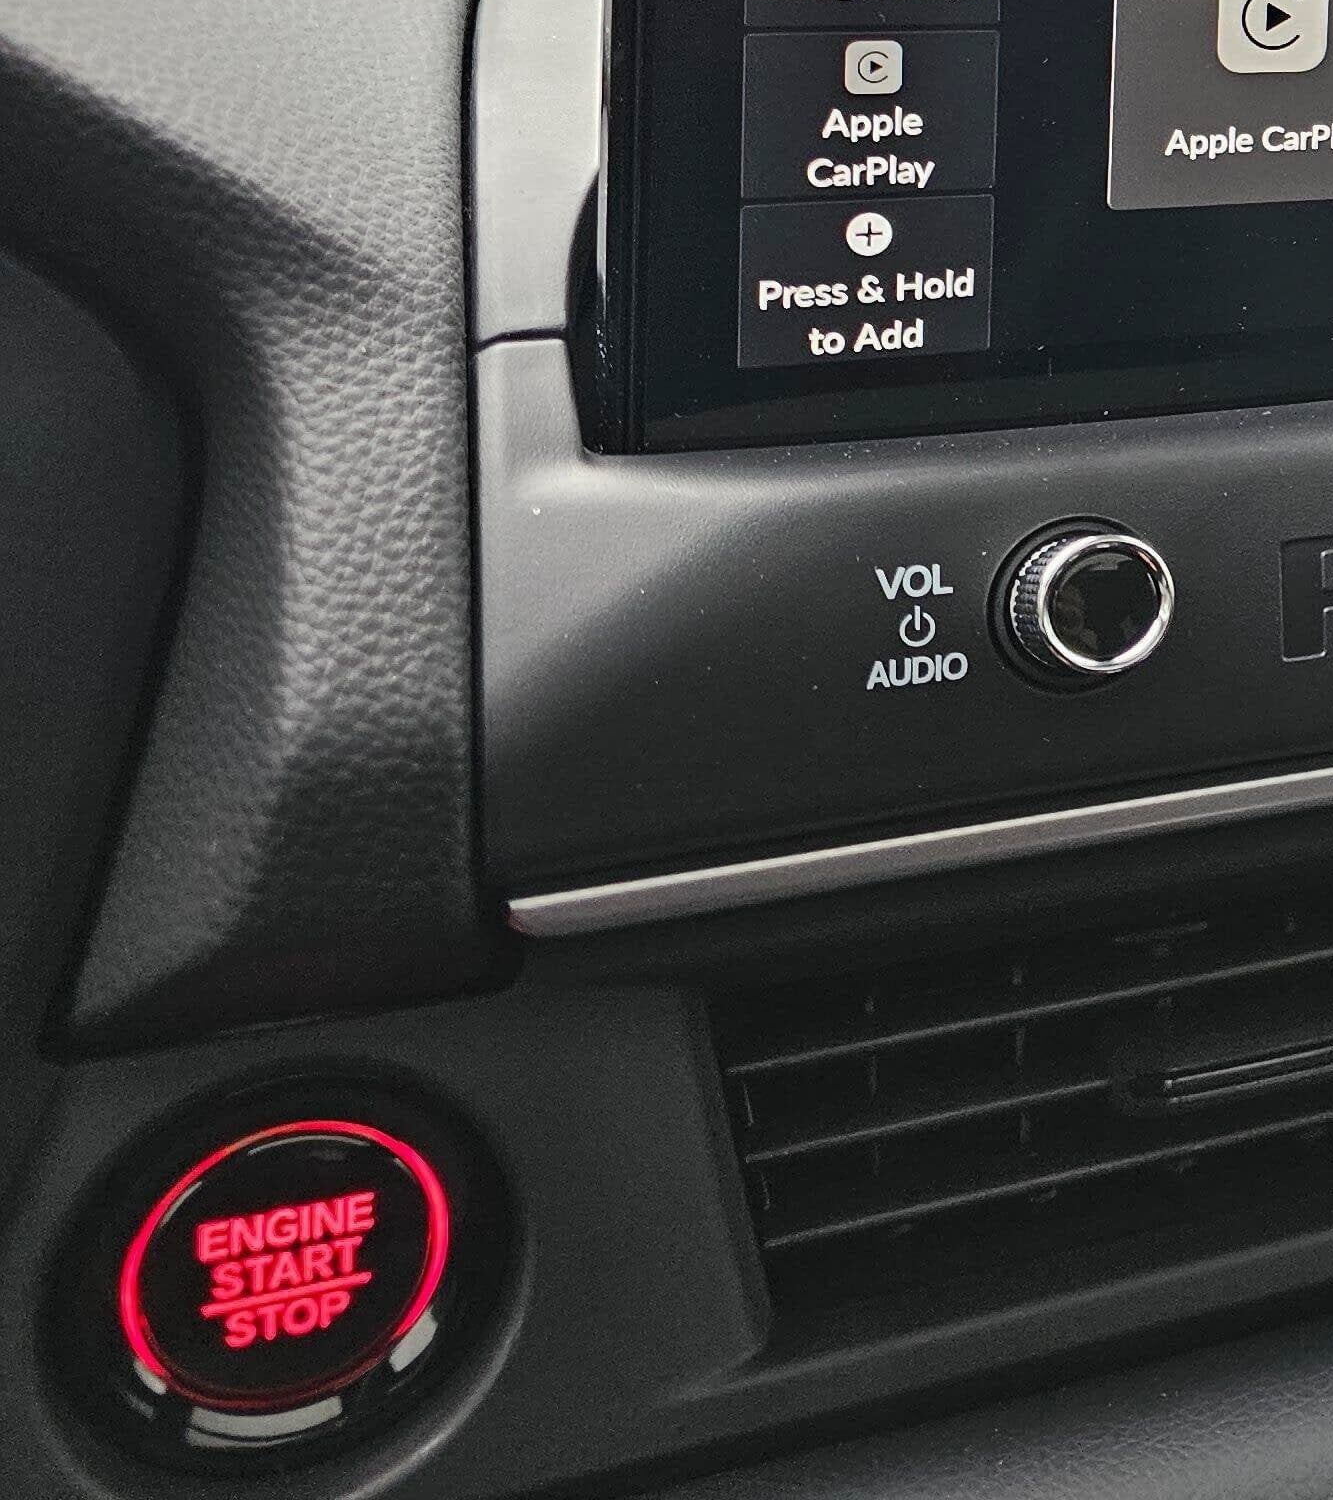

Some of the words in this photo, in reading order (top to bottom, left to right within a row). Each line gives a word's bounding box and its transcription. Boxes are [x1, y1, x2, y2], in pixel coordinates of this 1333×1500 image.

[822, 107, 924, 142] Apple
[1165, 127, 1254, 161] Apple
[806, 155, 936, 189] CarPlay
[758, 279, 849, 311] Press
[857, 275, 885, 305] &
[896, 268, 975, 301] Hold
[809, 327, 846, 356] to
[853, 319, 924, 352] Add
[875, 563, 953, 600] VOL
[865, 651, 969, 690] AUDIO
[196, 1191, 375, 1262] ENGINE
[211, 1236, 363, 1299] START
[225, 1291, 351, 1348] STOP
